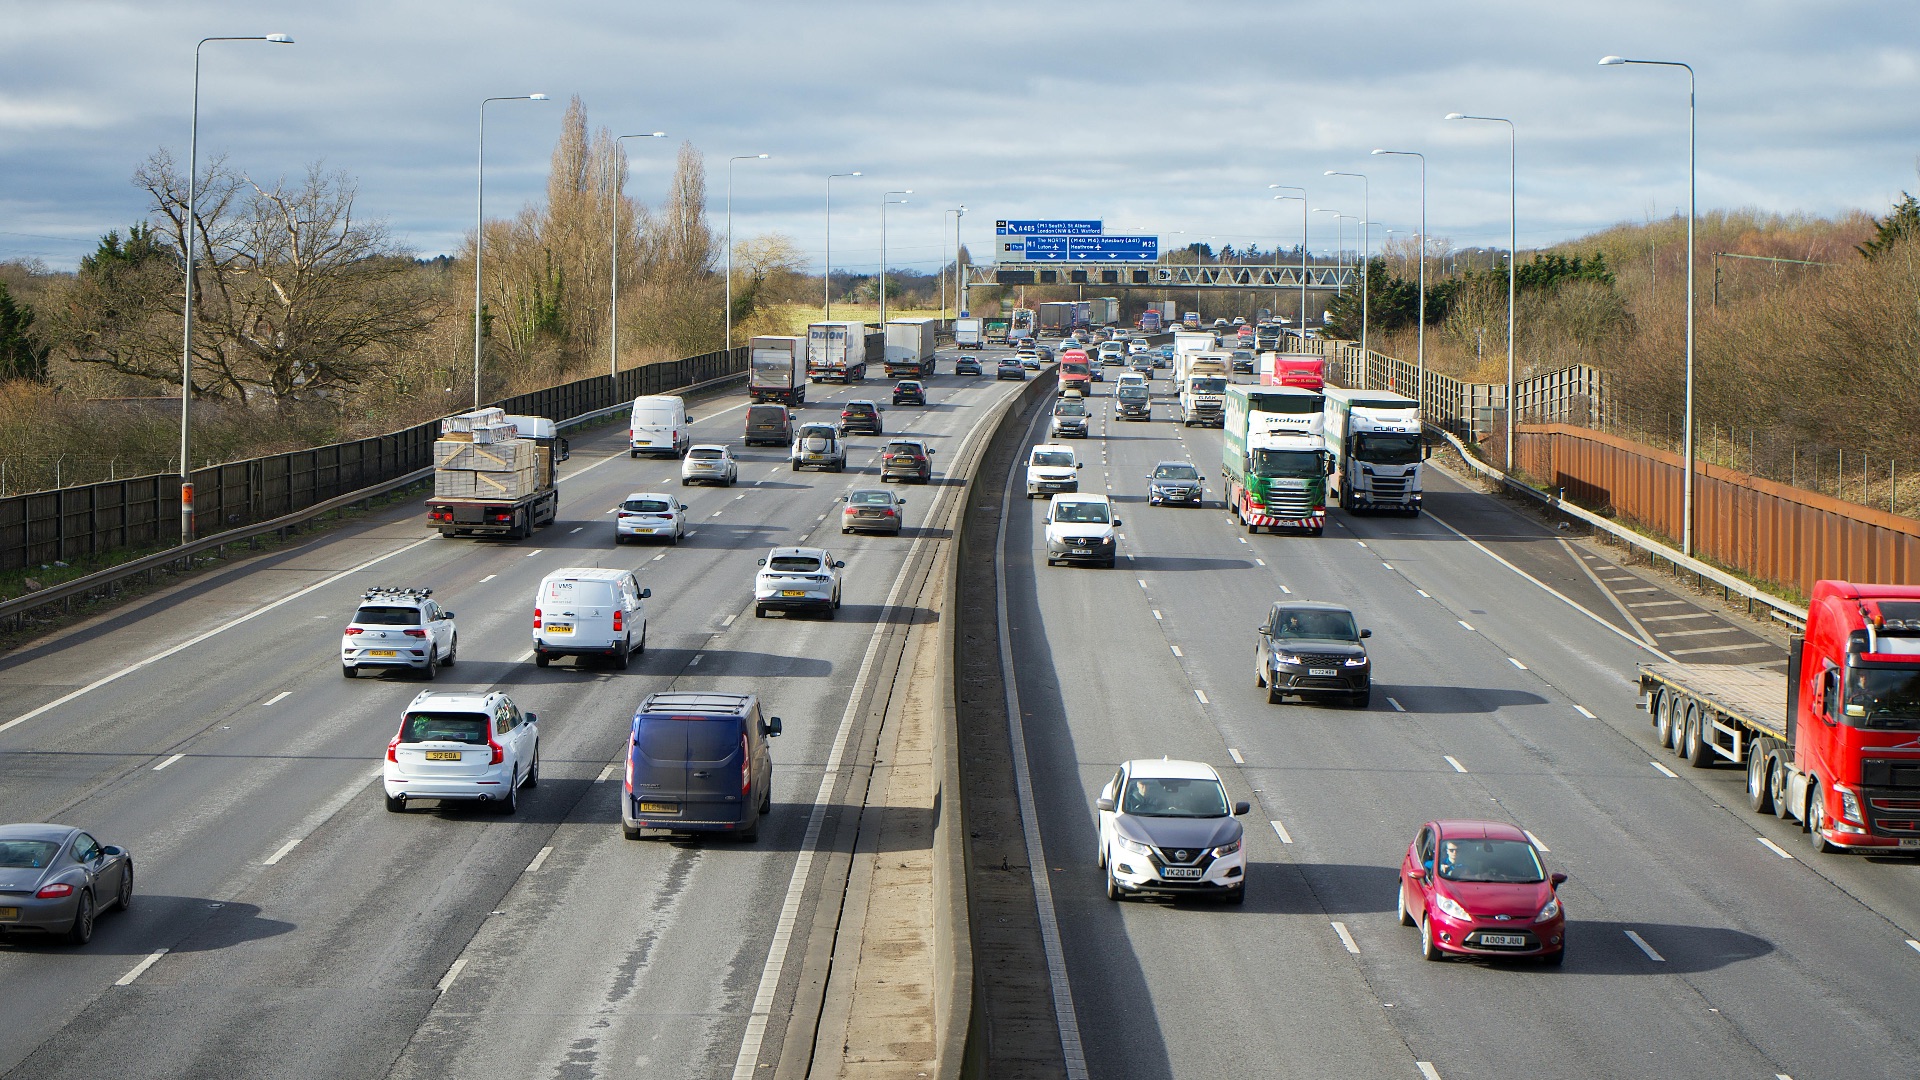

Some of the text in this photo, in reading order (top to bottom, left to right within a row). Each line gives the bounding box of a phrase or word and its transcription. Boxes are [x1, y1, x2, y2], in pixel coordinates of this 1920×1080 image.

[811, 331, 844, 340] DIXON
[1165, 868, 1201, 877] VK20 GWU
